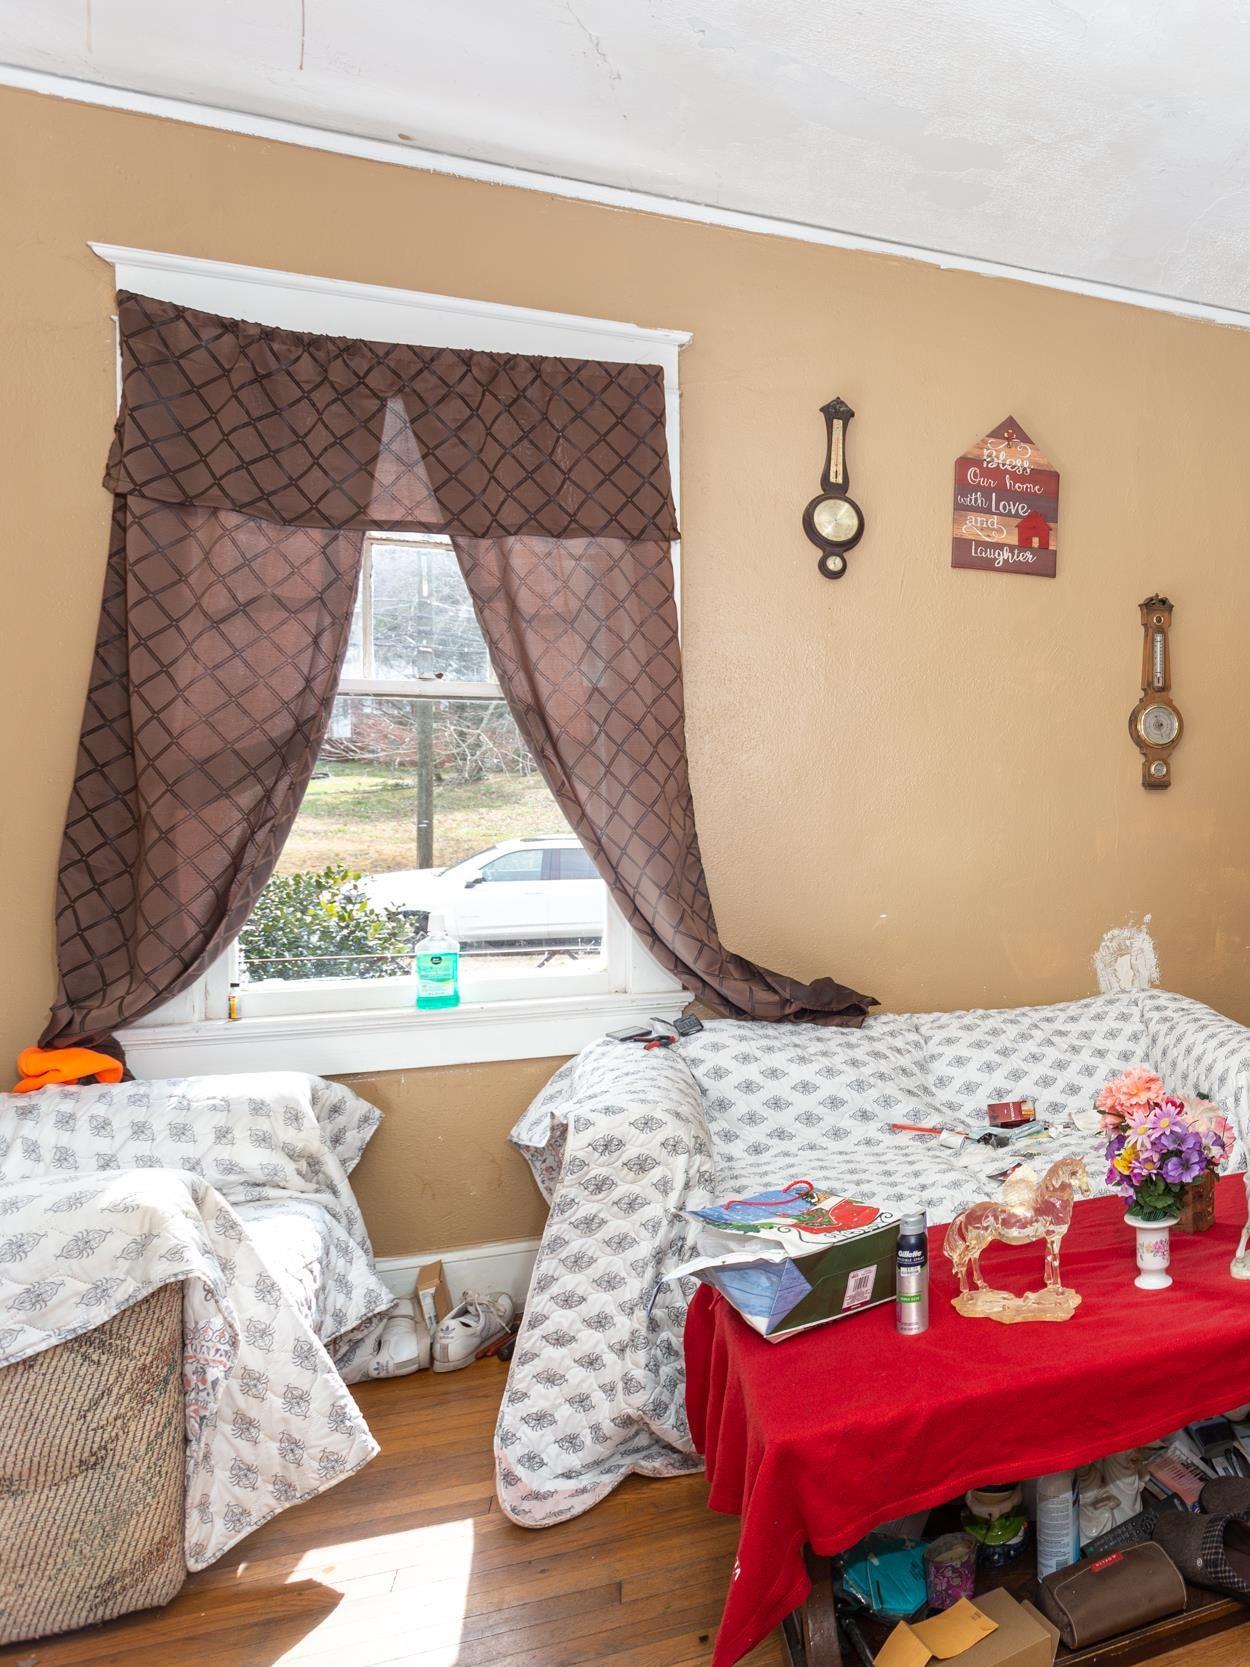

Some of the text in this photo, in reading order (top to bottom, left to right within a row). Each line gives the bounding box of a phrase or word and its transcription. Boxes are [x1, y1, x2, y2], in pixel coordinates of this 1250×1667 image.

[983, 446, 1032, 475] Bless
[967, 466, 1044, 494] Our home
[957, 492, 1031, 517] with Love
[966, 515, 999, 530] and
